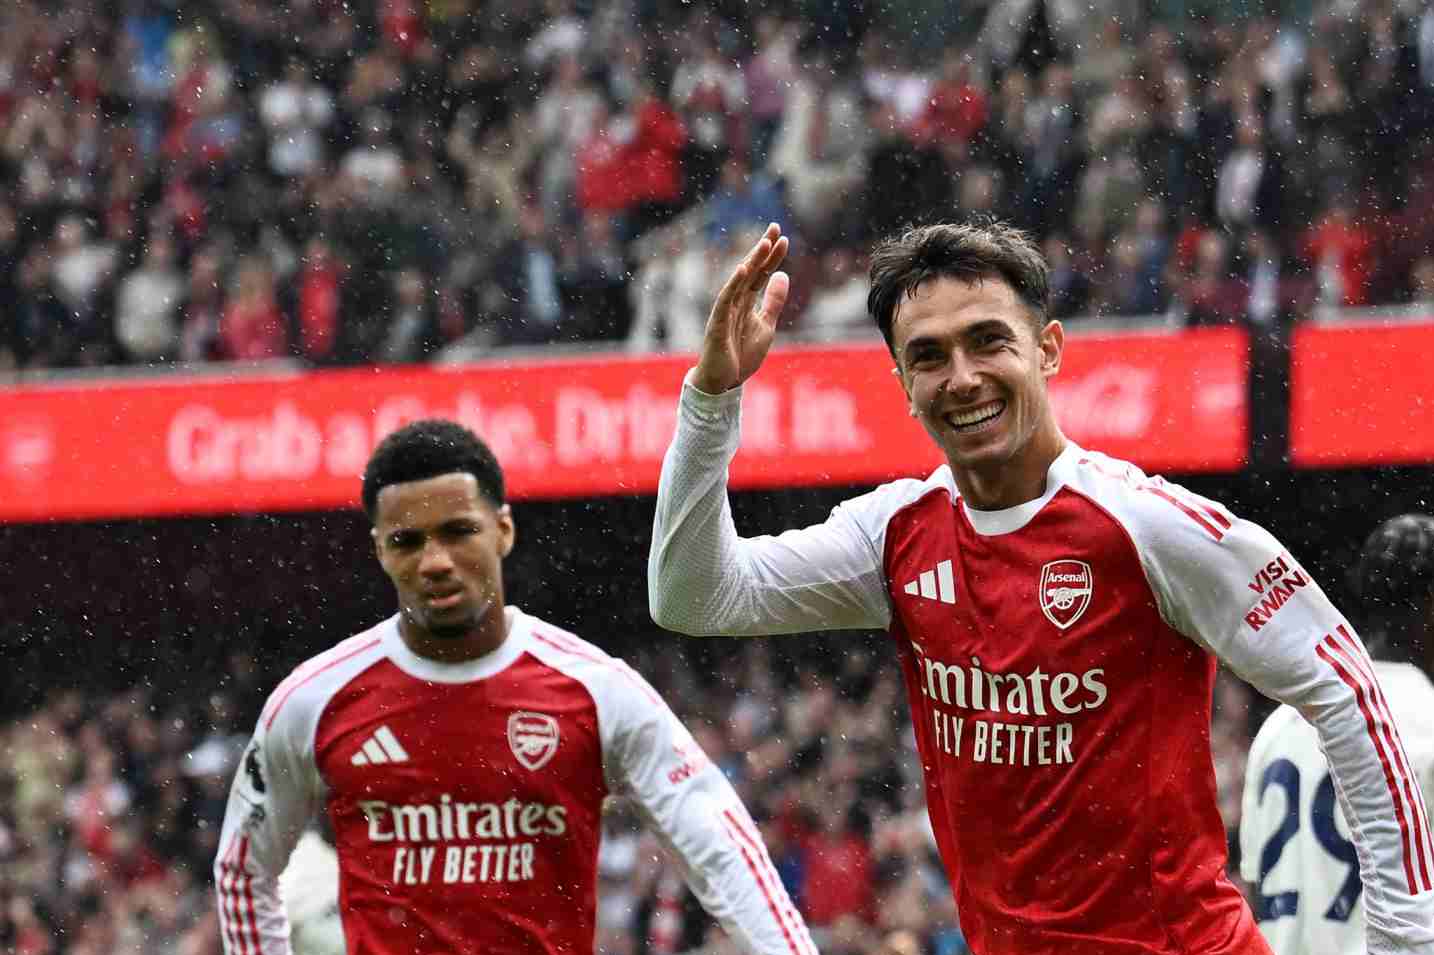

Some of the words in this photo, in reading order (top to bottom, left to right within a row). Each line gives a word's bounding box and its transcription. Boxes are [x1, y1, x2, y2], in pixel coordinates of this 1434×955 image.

[166, 398, 321, 484] Grab
[1047, 571, 1087, 584] Arsenal
[1247, 552, 1292, 594] VISI
[1243, 566, 1311, 632] RWAN
[933, 708, 964, 757] FLY
[972, 719, 1074, 767] BETTER
[357, 793, 568, 843] Emirates
[393, 846, 436, 886] FLY
[443, 842, 535, 885] BETTER
